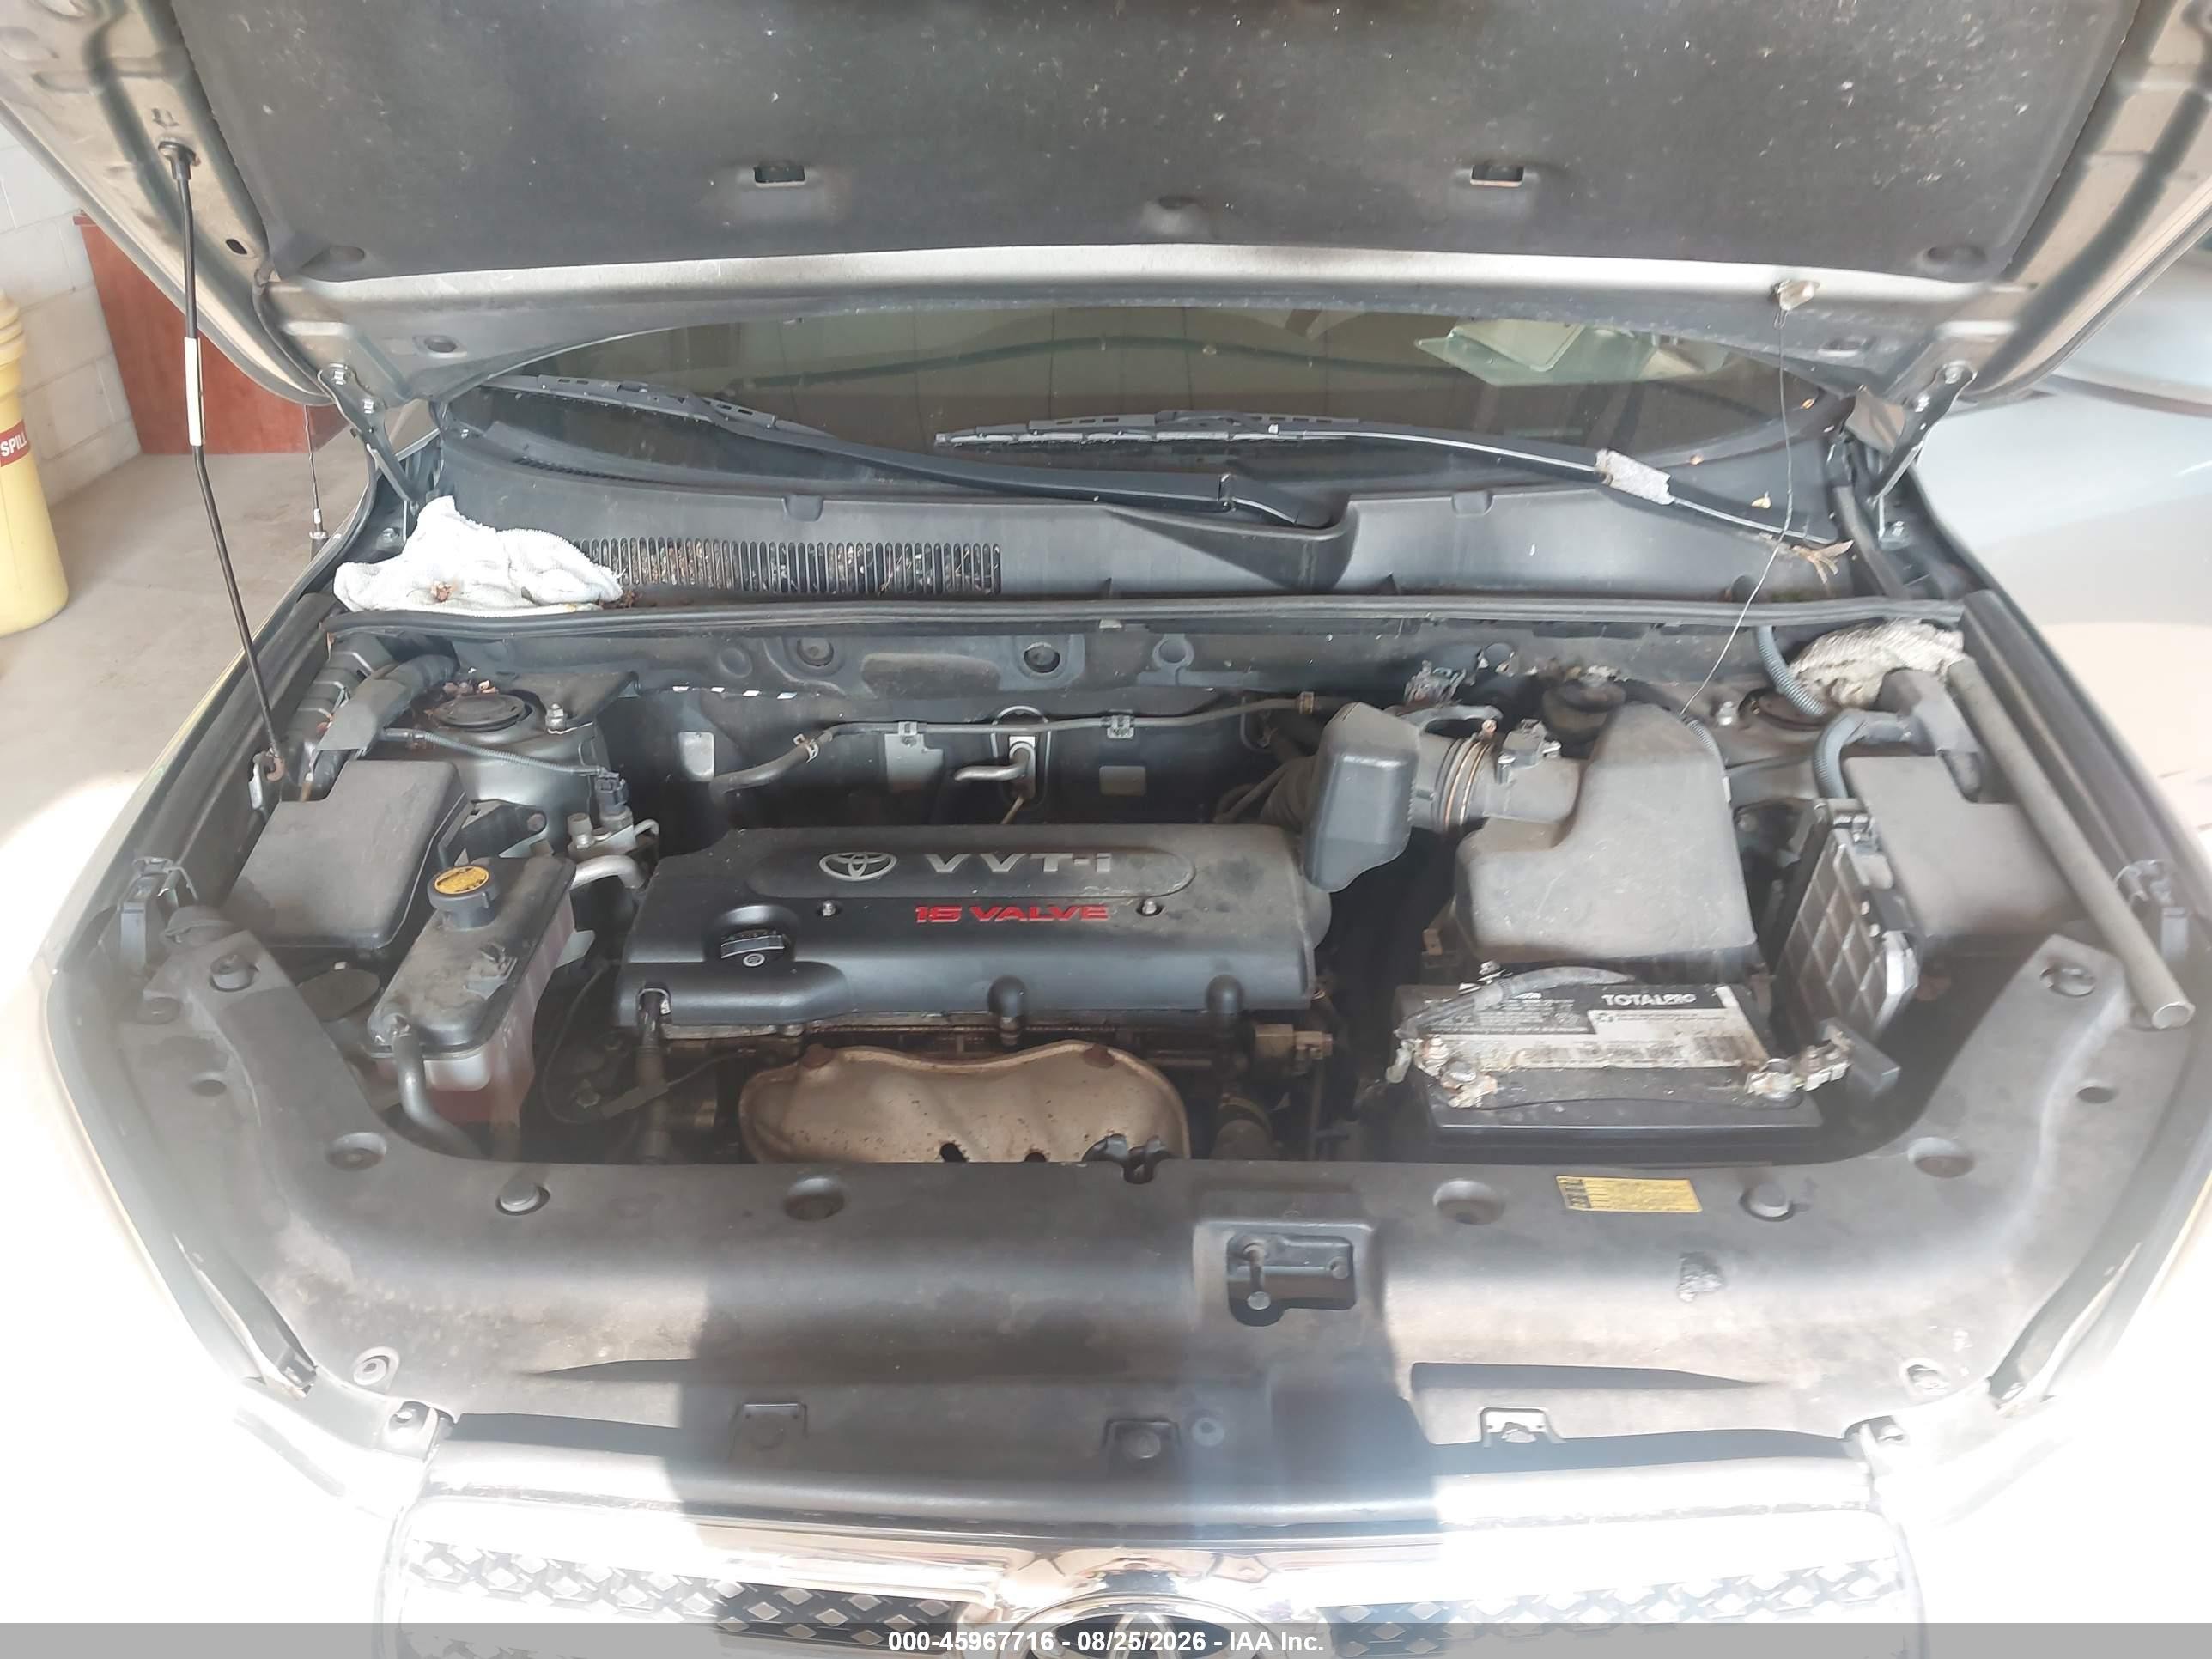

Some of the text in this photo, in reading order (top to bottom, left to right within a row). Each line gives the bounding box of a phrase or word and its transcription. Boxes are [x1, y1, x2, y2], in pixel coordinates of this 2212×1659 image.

[0, 431, 27, 457] SPILL
[924, 853, 1112, 873] VVT-i
[915, 906, 1110, 923] 16 VALVE
